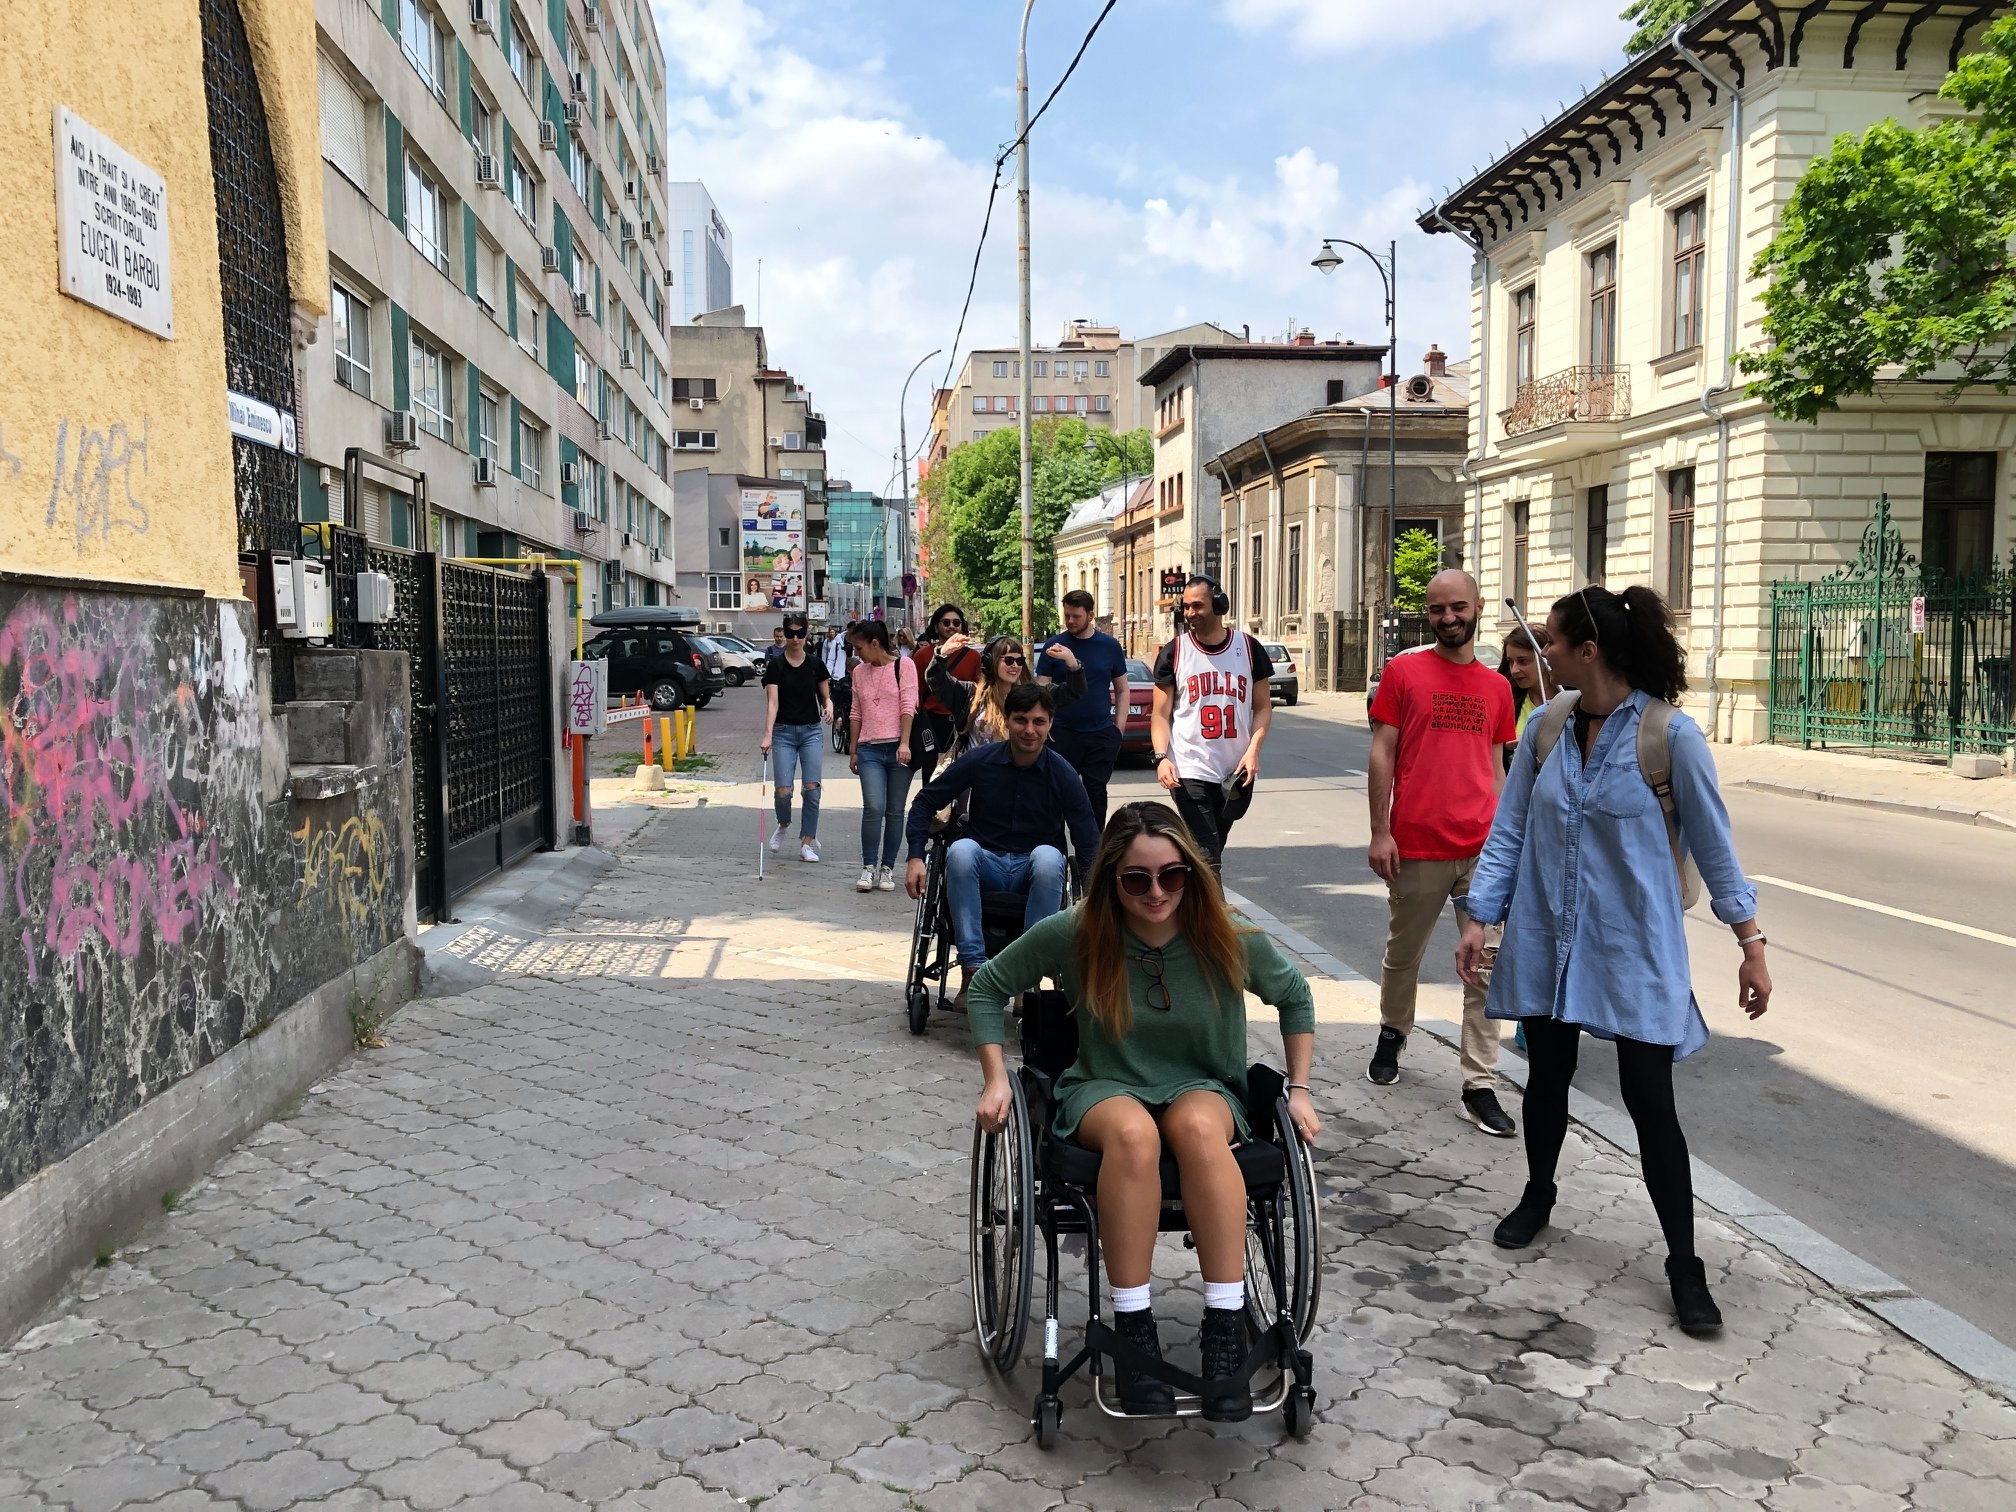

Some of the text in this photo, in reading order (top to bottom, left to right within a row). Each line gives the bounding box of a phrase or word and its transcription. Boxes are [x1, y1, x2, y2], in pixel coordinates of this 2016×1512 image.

[70, 135, 159, 210] AICI A TRAIT SI A CREAT
[77, 166, 158, 231] INTRE ANII 1960-1993
[94, 202, 145, 247] SCRIITORUL
[80, 220, 159, 292] EUGEN BARBU
[105, 272, 142, 308] 1924-1993
[1187, 671, 1247, 704] BULLS
[1432, 694, 1458, 702] DIESEL
[1432, 700, 1466, 708] SUMMER
[1201, 705, 1237, 739] 91
